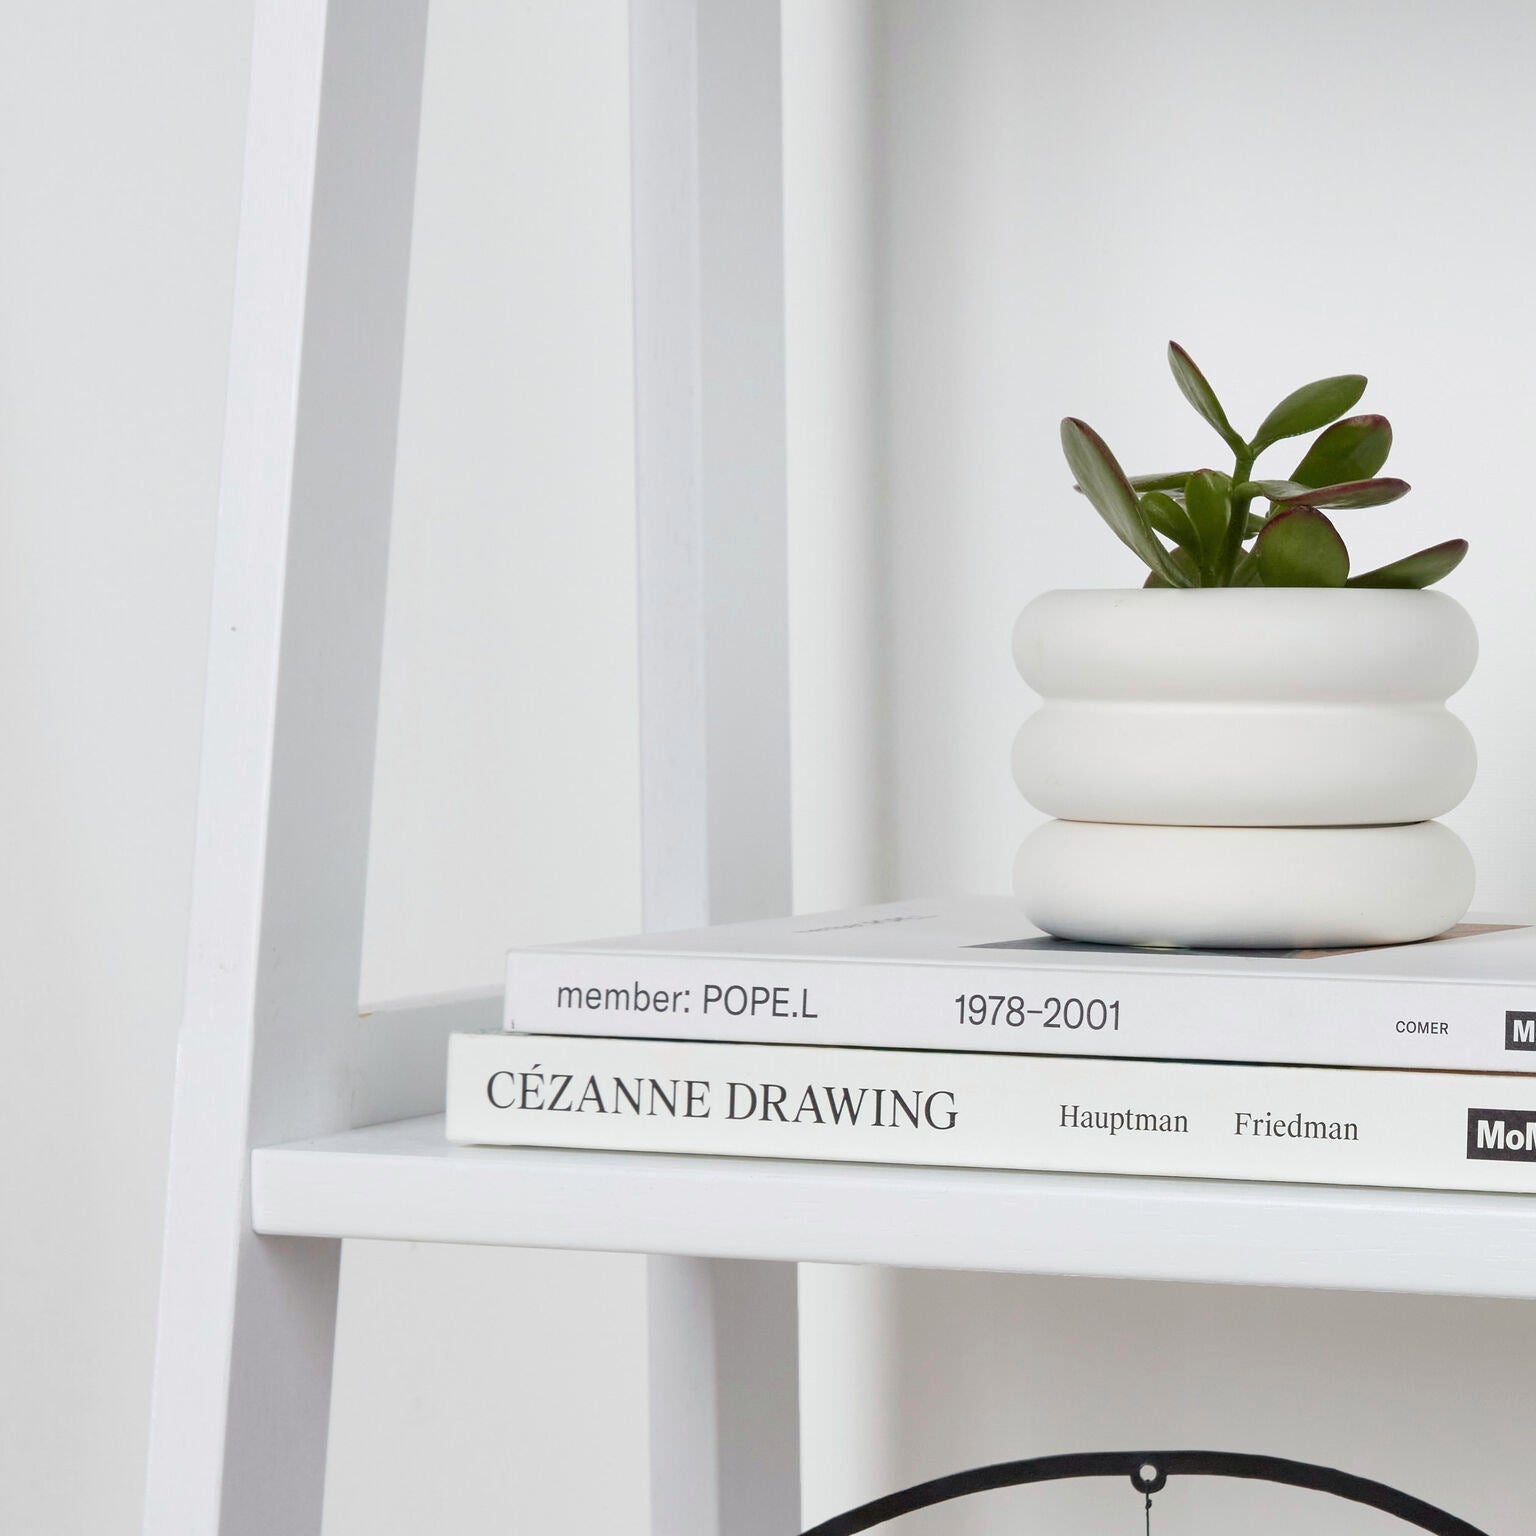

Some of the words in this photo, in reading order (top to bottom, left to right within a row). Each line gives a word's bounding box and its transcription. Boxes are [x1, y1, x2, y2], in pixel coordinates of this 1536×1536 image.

[557, 980, 690, 1013] member:
[703, 984, 818, 1019] POPE.L
[1395, 1020, 1449, 1035] COMER
[487, 1063, 711, 1119] CÉZANNE
[725, 1082, 958, 1131] DRAWING
[1059, 1103, 1189, 1136] Hauptman
[1235, 1111, 1359, 1142] Friedman
